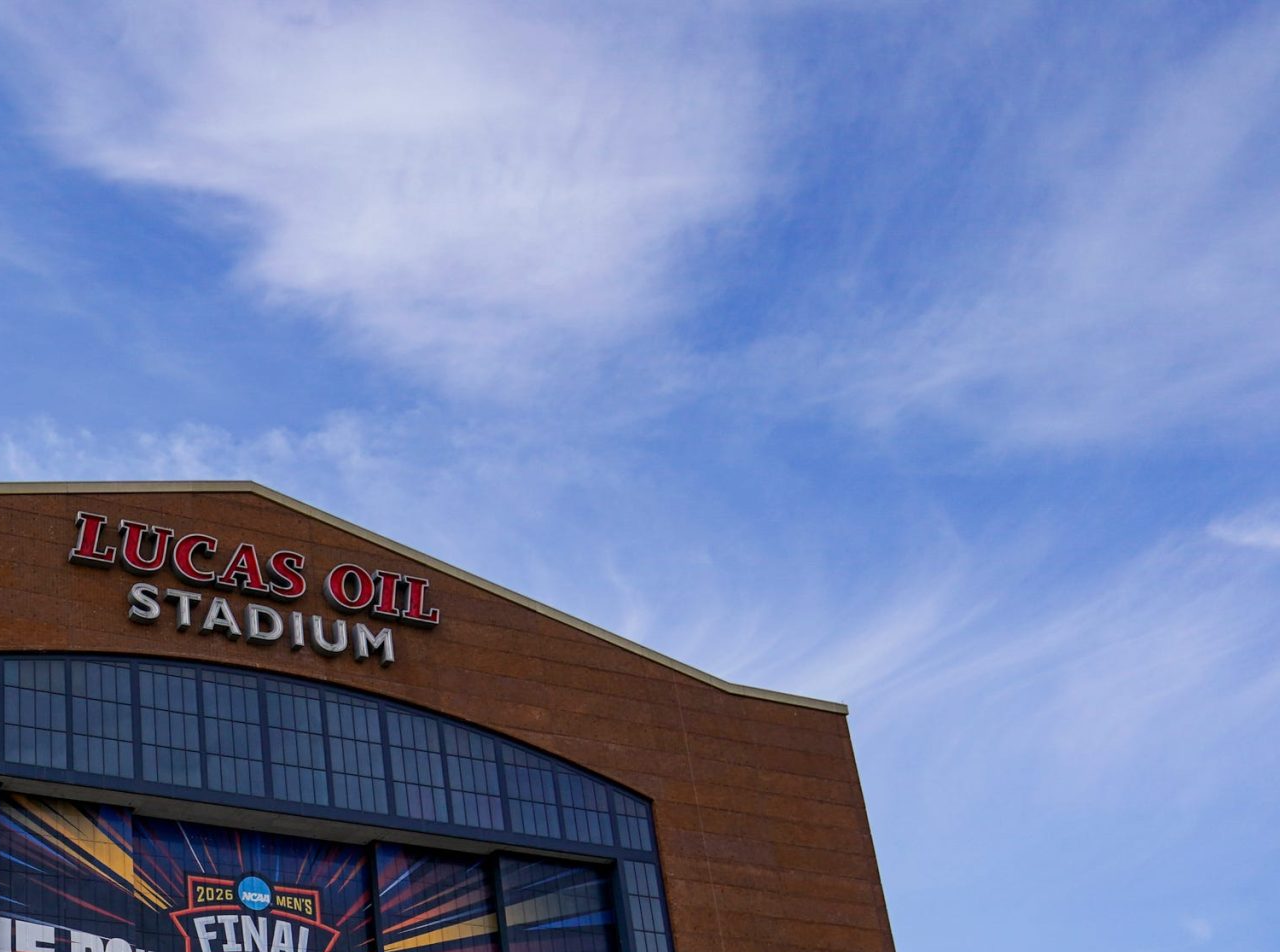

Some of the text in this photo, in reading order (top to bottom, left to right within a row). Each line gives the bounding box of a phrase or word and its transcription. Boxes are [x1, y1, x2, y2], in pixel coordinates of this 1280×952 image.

[69, 511, 440, 629] LUCAS OIL
[128, 582, 395, 668] STADIUM
[196, 886, 313, 915] 2026 NCAA MEN'S
